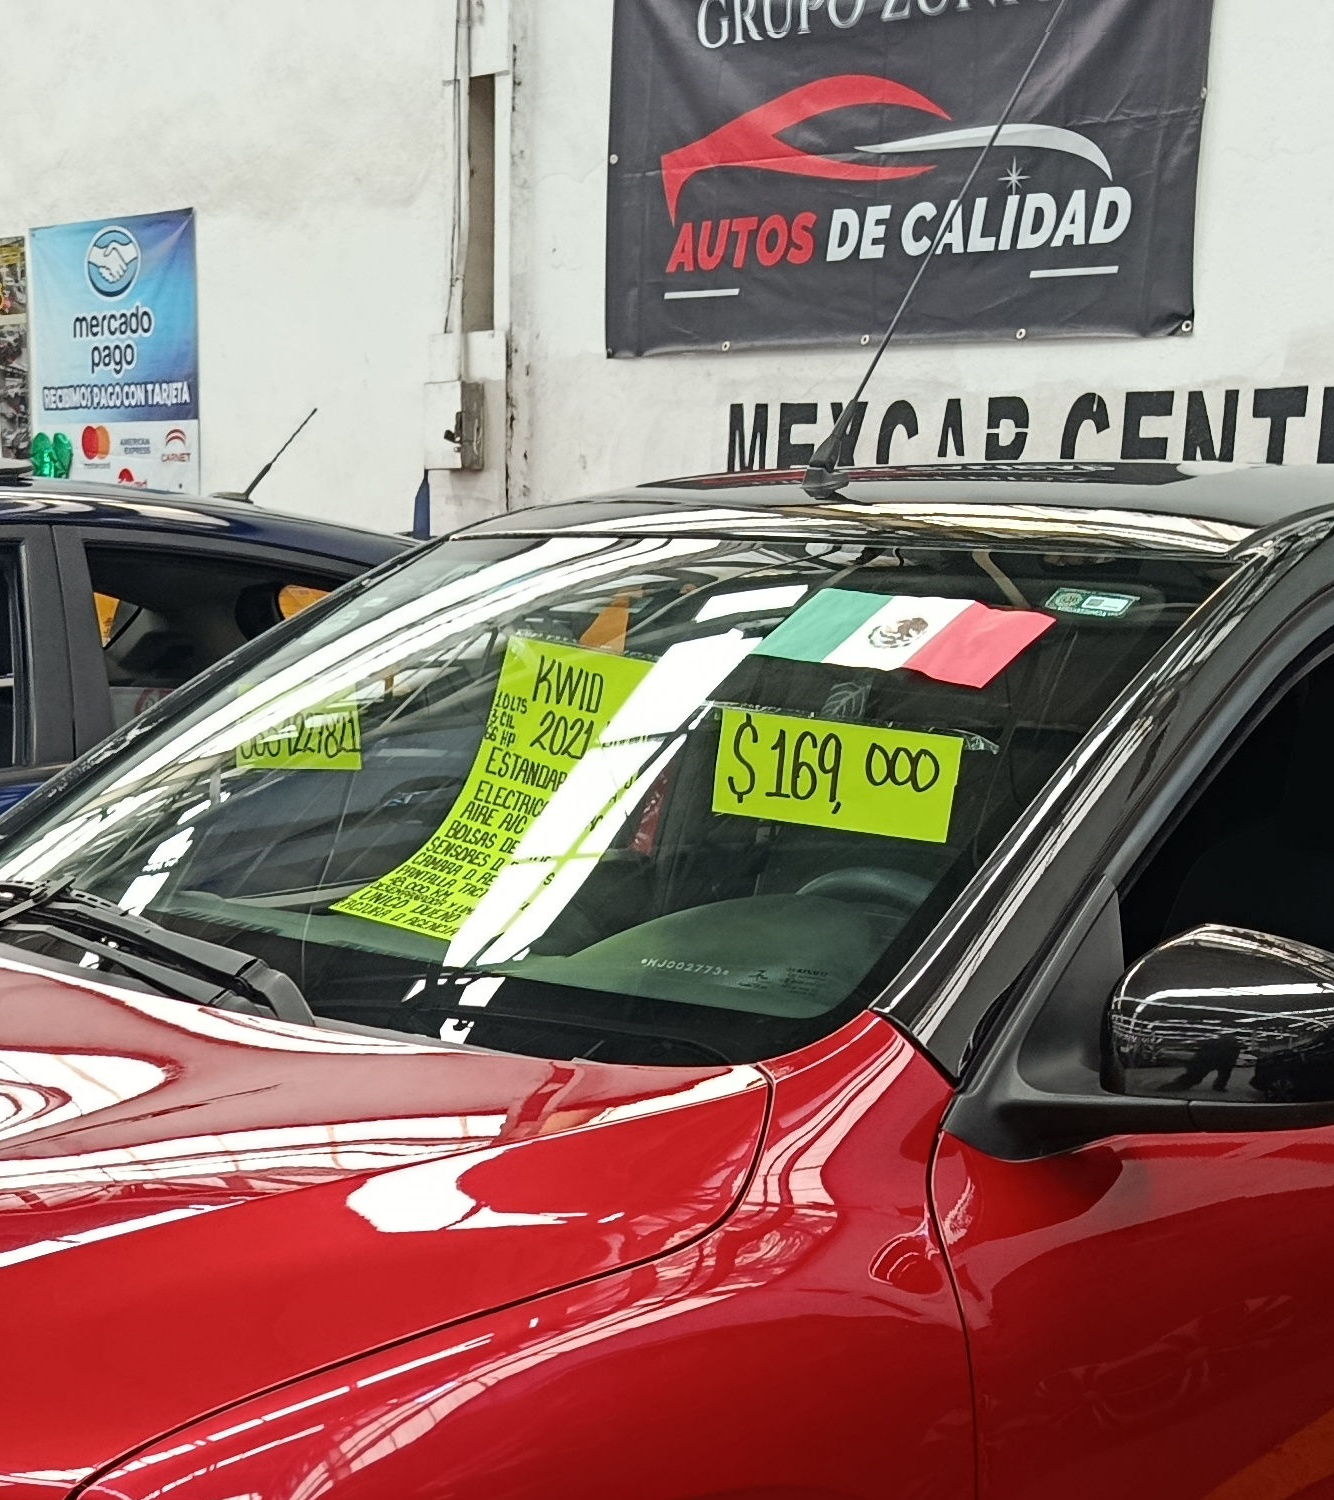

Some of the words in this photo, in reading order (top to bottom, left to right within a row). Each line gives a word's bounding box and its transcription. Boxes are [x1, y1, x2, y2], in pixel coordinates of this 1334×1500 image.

[666, 211, 817, 273] AUTOS
[826, 204, 892, 262] DE
[900, 186, 1133, 257] CALIDAD
[73, 304, 153, 339] mercado
[90, 342, 135, 374] pago
[90, 383, 119, 409] PAGO
[120, 382, 142, 407] CON
[143, 380, 191, 406] TARJETA
[532, 654, 604, 715] KWID
[529, 709, 595, 761] 2021
[865, 742, 940, 793] 000
[459, 800, 499, 828] AIRE
[473, 779, 551, 819] ELECTRIC
[425, 835, 492, 867] SENSORES
[444, 819, 498, 849] BOLSAS
[498, 836, 521, 855] DE
[394, 864, 459, 889] PANTALLA
[411, 851, 464, 877] CAMARA
